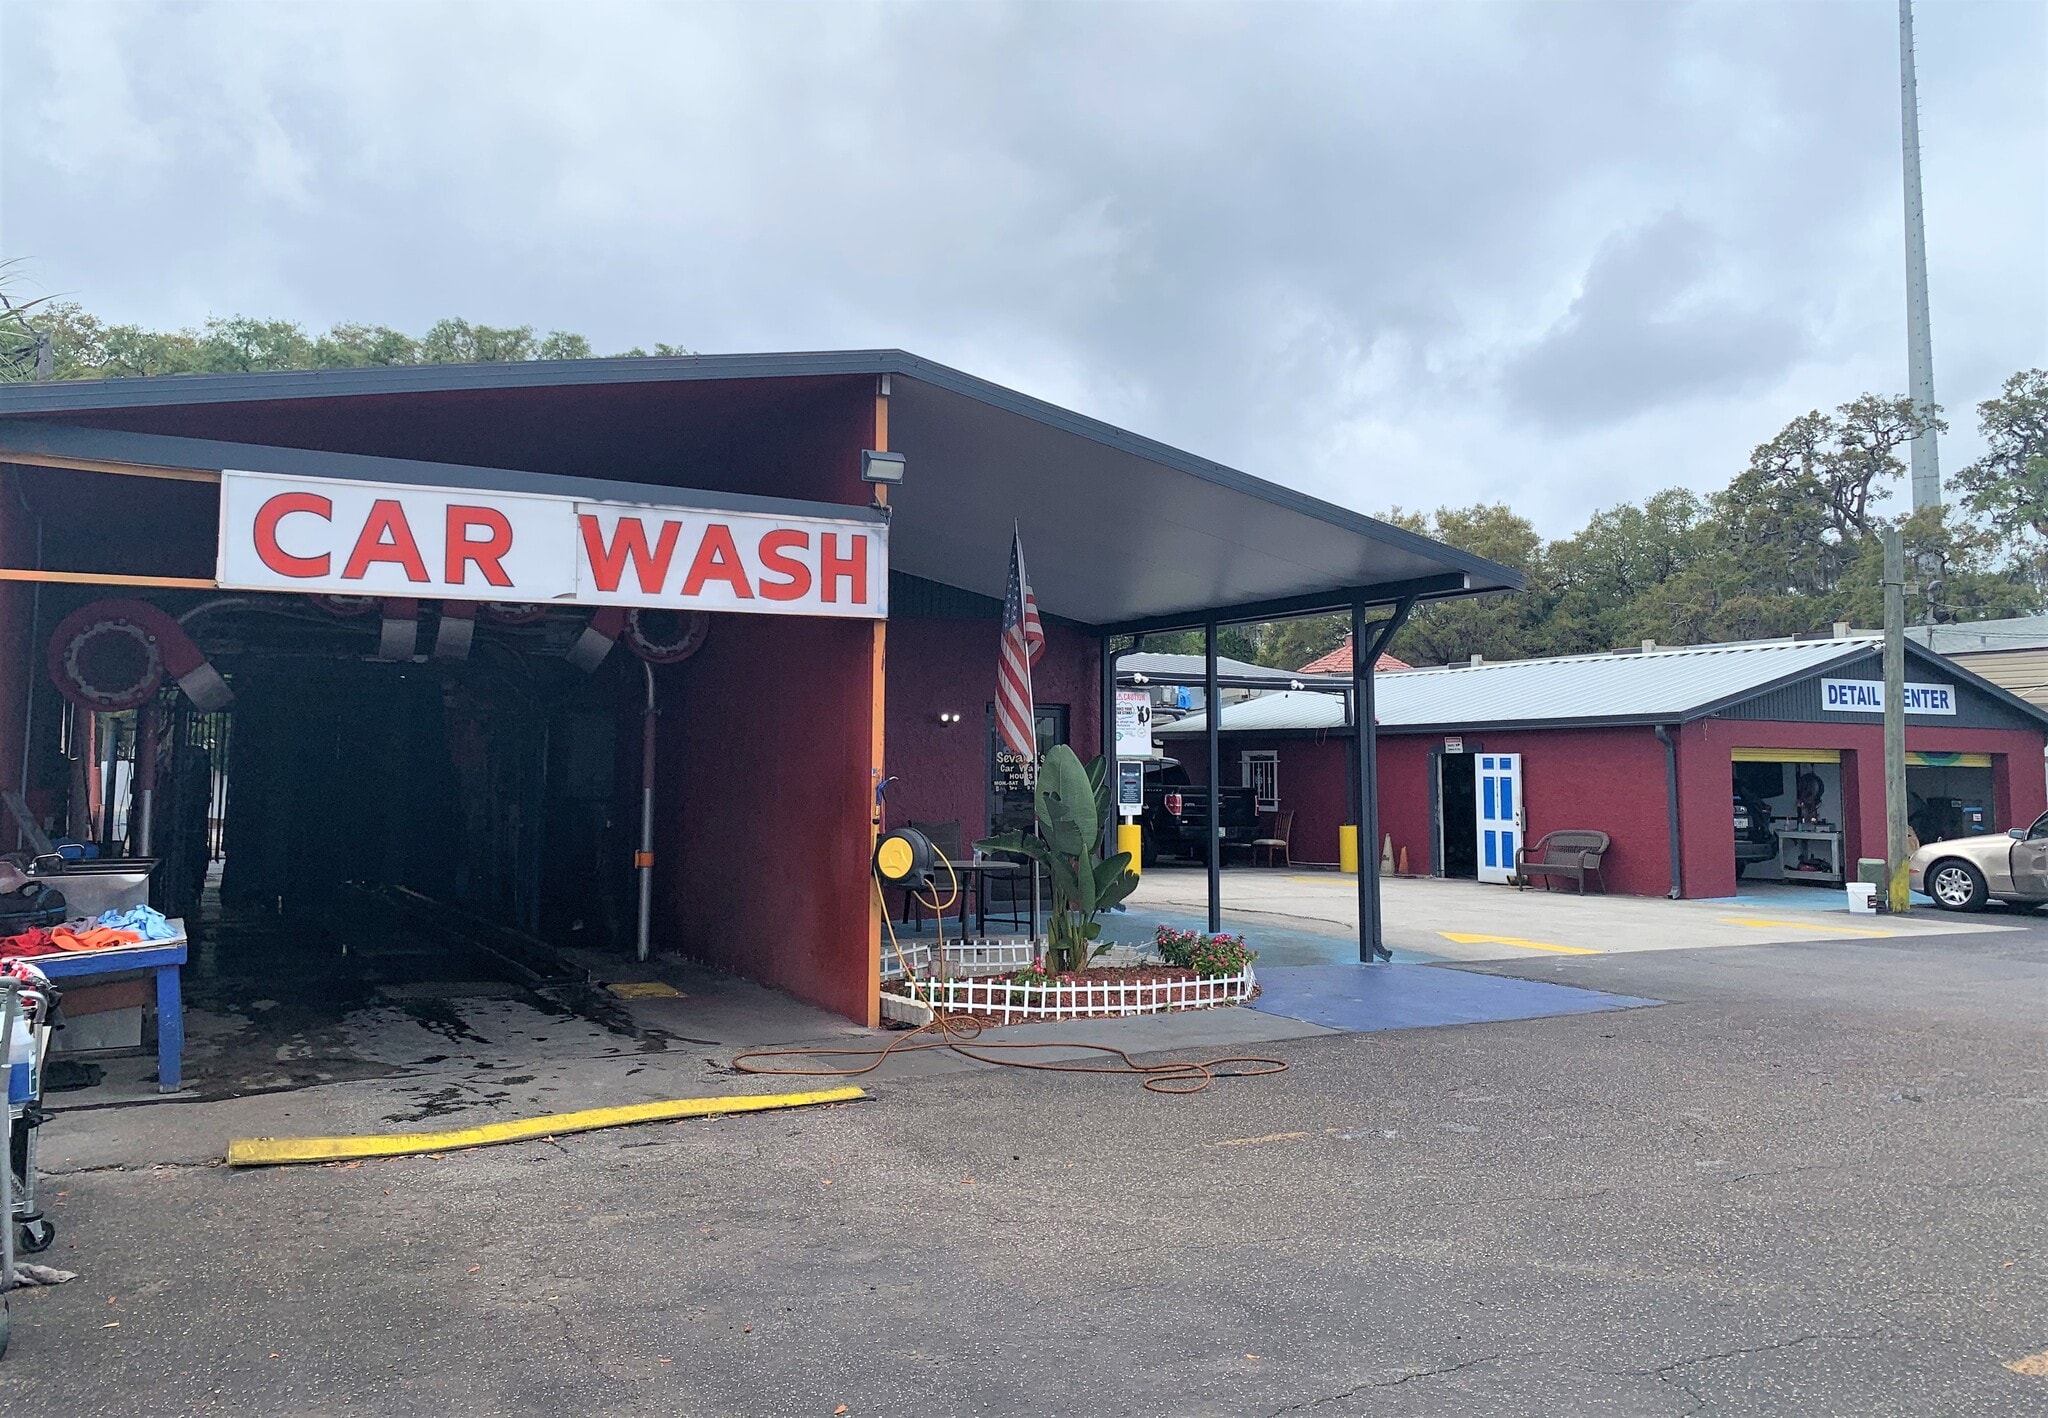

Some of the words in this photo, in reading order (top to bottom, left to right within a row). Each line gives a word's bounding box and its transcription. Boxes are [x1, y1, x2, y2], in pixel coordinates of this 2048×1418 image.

[253, 491, 514, 587] CAR
[578, 513, 868, 605] WASH
[1828, 684, 1881, 706] DETAIL
[1903, 689, 1949, 709] ENTER
[1000, 764, 1014, 772] Car
[1019, 764, 1042, 772] Wah
